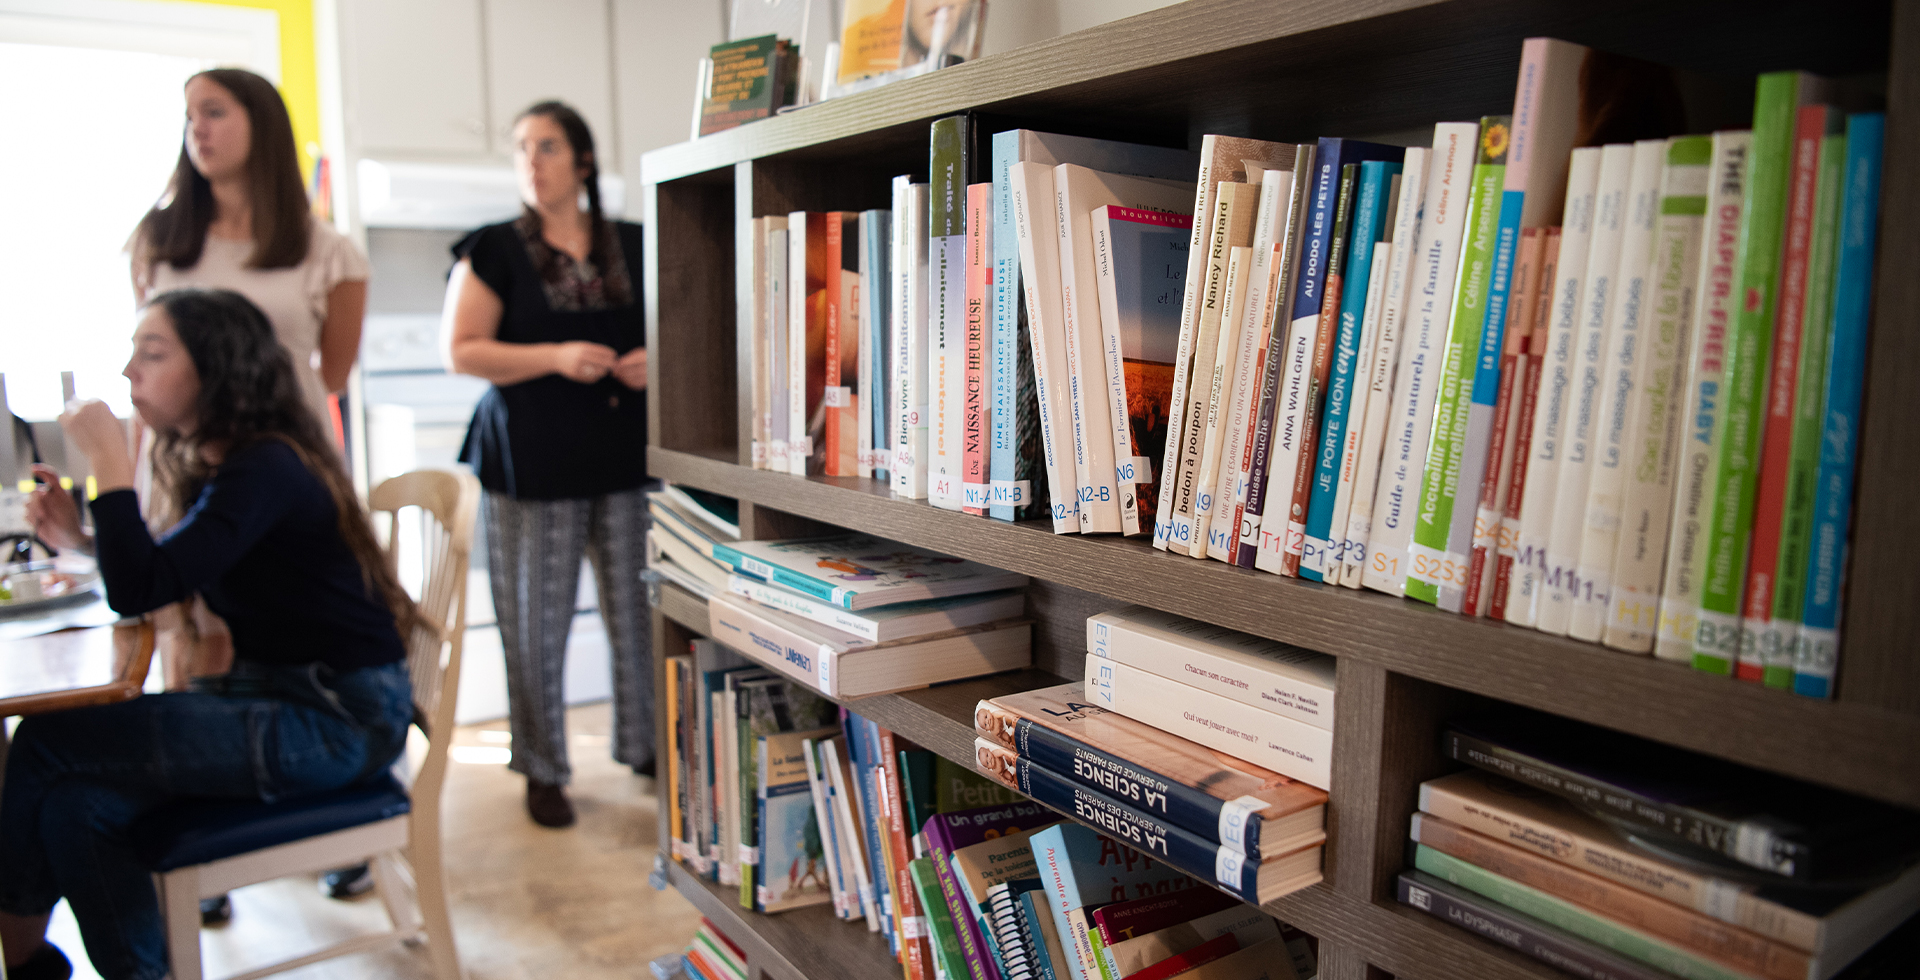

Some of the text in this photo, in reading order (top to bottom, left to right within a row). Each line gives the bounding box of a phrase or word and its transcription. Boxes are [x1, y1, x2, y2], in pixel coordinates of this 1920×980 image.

[1723, 146, 1746, 194] THE
[1121, 209, 1183, 224] Nouvelles
[1435, 188, 1449, 224] Céline
[1304, 164, 1330, 297] AU DODO LES PETITS
[1463, 176, 1496, 309] Céline Arsenault
[1100, 253, 1108, 276] Michel
[1206, 201, 1227, 309] Nancy Richard
[1166, 264, 1181, 280] Le
[1704, 204, 1740, 372] DIAPER-FREE
[899, 272, 908, 374] l'allaitement
[1182, 291, 1192, 329] douleur
[1383, 308, 1394, 342] peau
[1006, 340, 1010, 348] et
[1179, 346, 1186, 358] de
[1180, 332, 1187, 342] la
[1381, 346, 1388, 354] à
[1555, 331, 1570, 363] des
[1585, 331, 1602, 363] des
[1619, 333, 1636, 366] des
[1176, 363, 1184, 383] faire
[1238, 330, 1253, 397] ACCOUCHEMENT
[1372, 358, 1386, 392] Peau
[1108, 334, 1126, 445] Le Fermier et l'Accoucheur
[1173, 387, 1182, 407] Que
[1282, 336, 1306, 450] ANNA WAHLGREN
[1385, 239, 1441, 528] Guide de soins naturels pour la famille
[1005, 396, 1009, 404] sa
[1236, 397, 1244, 410] UN
[1319, 311, 1355, 492] JE PORTE MON enfant
[1546, 366, 1568, 437] massage
[1577, 367, 1599, 438] massage
[1610, 370, 1634, 444] massage
[1696, 381, 1718, 443] BABY
[1168, 413, 1178, 448] bientôt.
[1234, 412, 1242, 425] OU
[1246, 336, 1280, 511] Fausse couche Vrai deuil
[1420, 342, 1462, 524] Accueillir mon enfant
[1226, 427, 1240, 474] CÉSARIENNE
[1443, 378, 1473, 496] naturellement
[1539, 440, 1555, 461] Le
[1569, 441, 1587, 464] Le
[1117, 463, 1135, 481] N6
[1178, 401, 1201, 513] bedon à poupon
[1343, 452, 1353, 482] PORTER
[1603, 446, 1620, 468] Le
[937, 480, 949, 495] A1
[1161, 450, 1174, 503] J'accouche
[1223, 476, 1233, 501] AUTRE
[994, 486, 1022, 501] N1-B
[1077, 485, 1110, 502] N2-B
[1220, 502, 1229, 518] UNE
[1171, 520, 1189, 541] N8
[1241, 519, 1261, 538] D1
[1261, 530, 1281, 553] T1
[1284, 528, 1304, 550] T2
[1302, 542, 1325, 567] P1
[1373, 552, 1399, 576] S1
[1096, 622, 1108, 658] E16
[1100, 665, 1111, 703] E17
[1184, 663, 1249, 690] Chacun son caractère
[1073, 758, 1166, 812] LA SCIENCE
[1075, 747, 1168, 792] AU SERVICE DES PARENTS
[948, 802, 1040, 827] Un grand bol
[1074, 788, 1167, 836] AU SERVICE DES PARENTS
[1074, 799, 1167, 855] LA SCIENCE
[934, 846, 947, 874] ADOS
[988, 845, 1030, 863] Parents
[943, 876, 955, 897] AUX
[981, 870, 993, 878] De
[994, 867, 1003, 875] la
[952, 899, 974, 955] RÉSERVÉES
[1113, 908, 1131, 918] ANNE
[1448, 905, 1521, 944] LA DYSPHASIE
